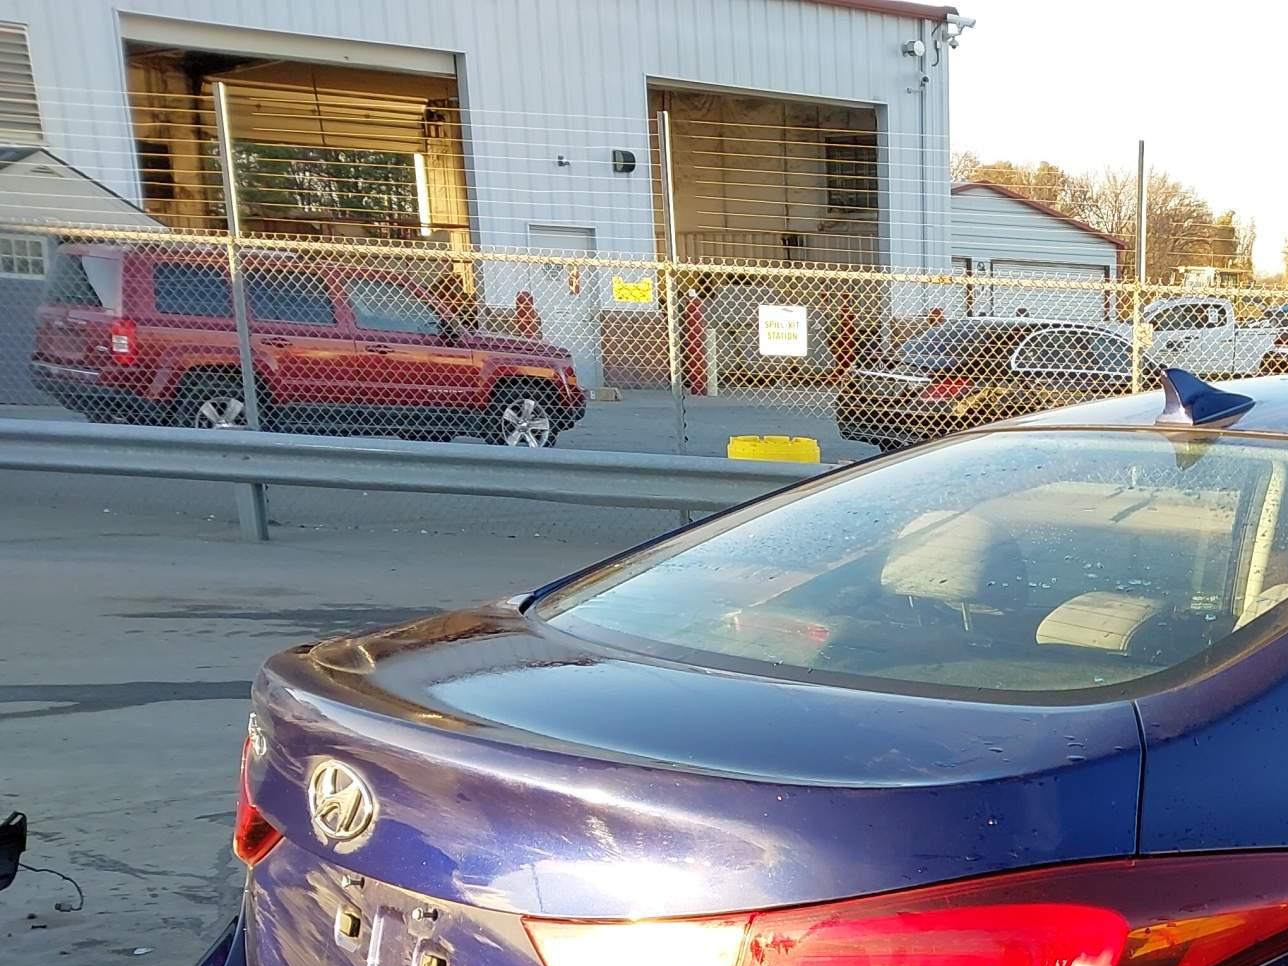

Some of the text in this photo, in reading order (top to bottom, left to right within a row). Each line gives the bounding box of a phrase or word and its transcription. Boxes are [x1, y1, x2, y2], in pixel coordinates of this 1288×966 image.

[764, 320, 800, 329] SPILL KIT
[768, 331, 798, 341] STATION
